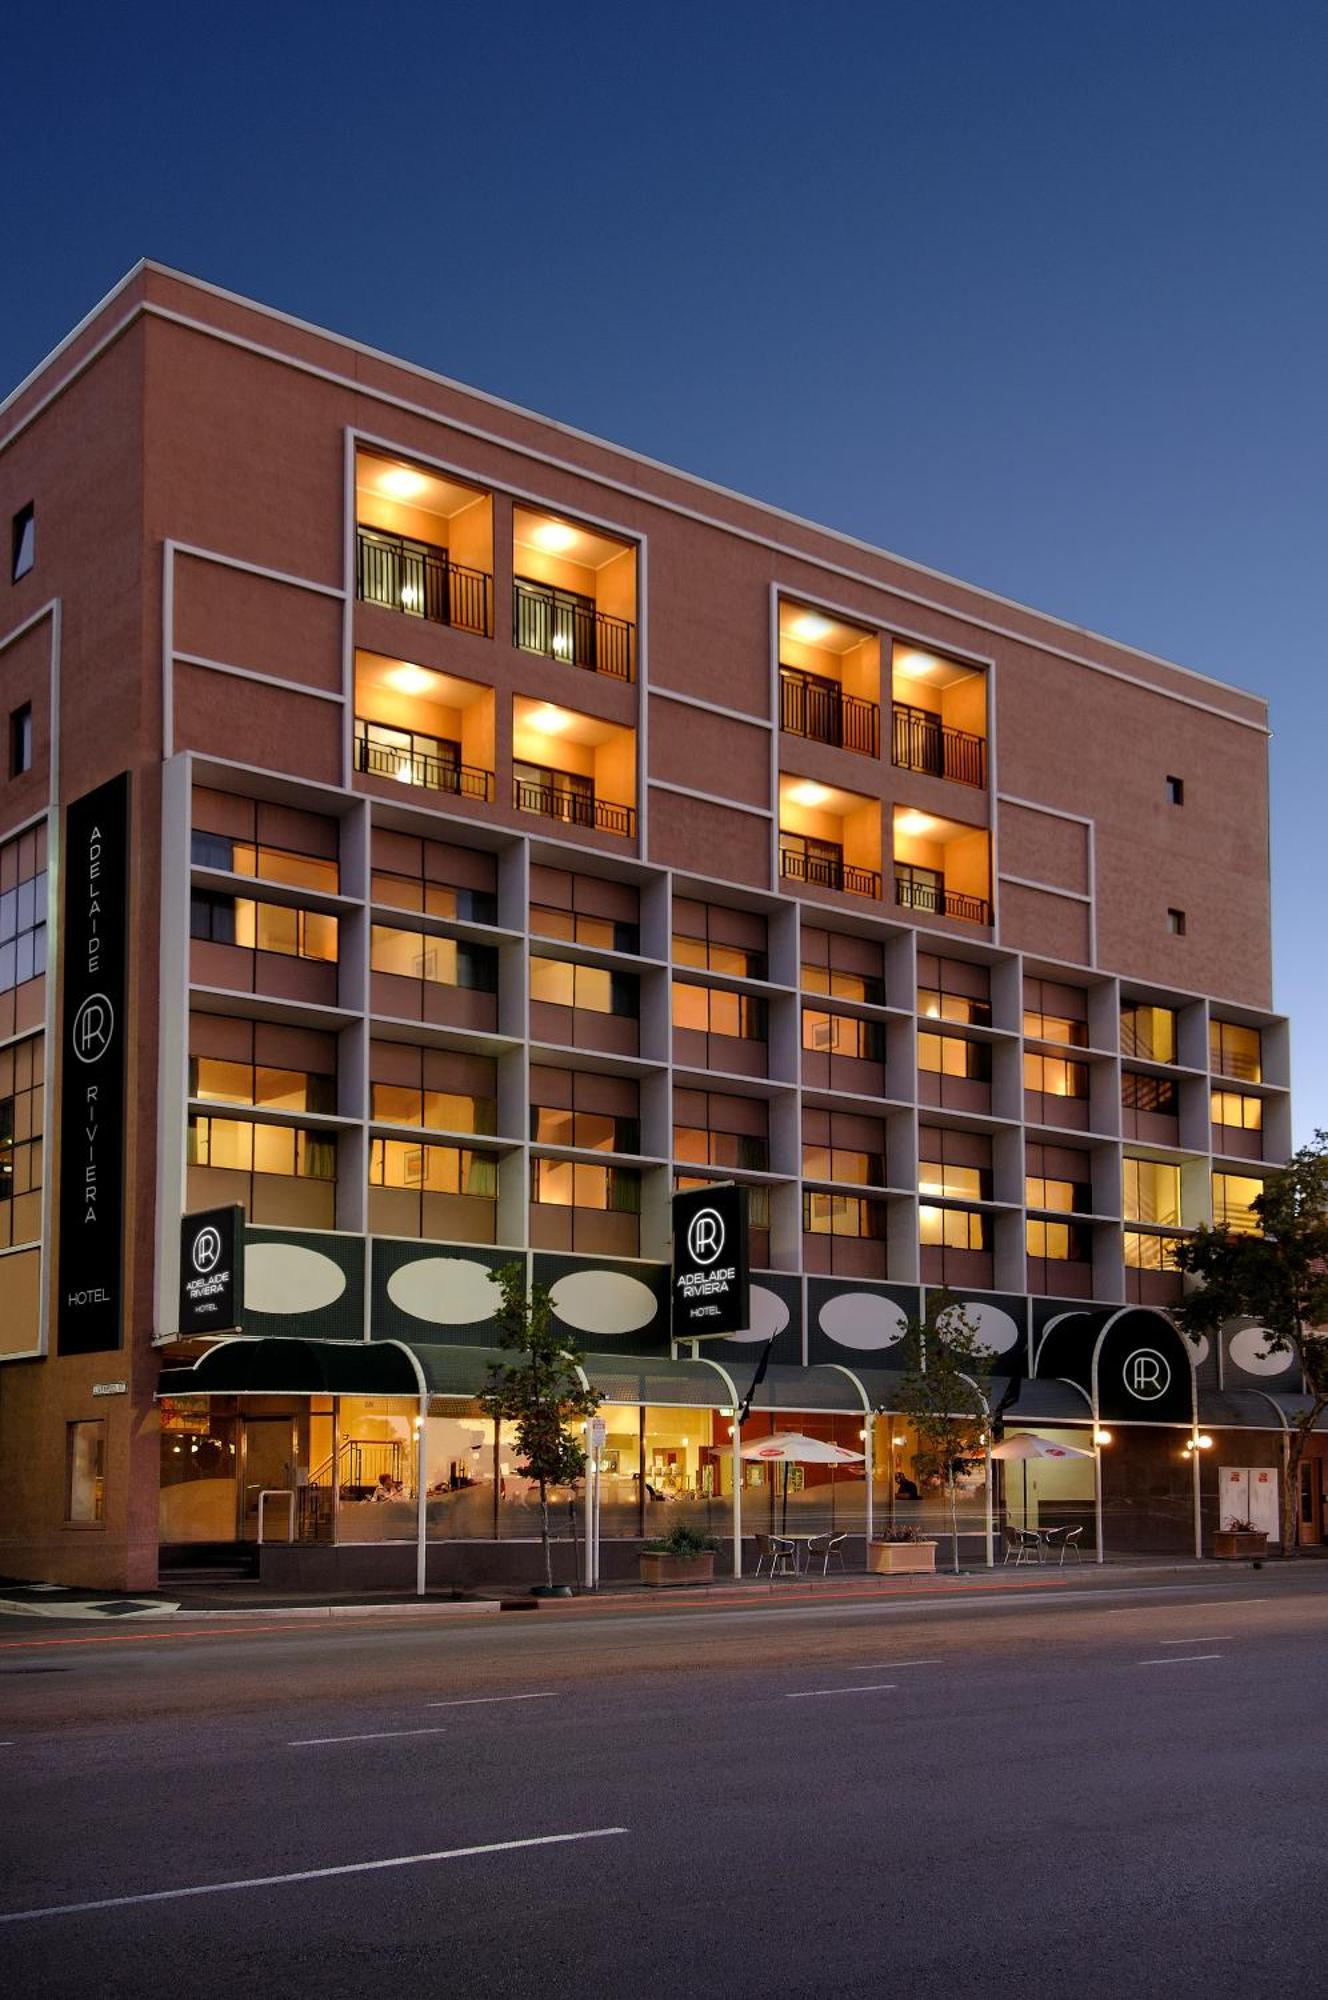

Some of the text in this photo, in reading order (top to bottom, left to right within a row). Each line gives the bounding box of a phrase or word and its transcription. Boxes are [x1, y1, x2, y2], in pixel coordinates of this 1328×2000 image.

[88, 826, 102, 973] ADELAIDE
[85, 1085, 98, 1223] RIVIERA
[186, 1272, 229, 1291] ADELAIDE
[677, 1268, 735, 1288] ADELAIDE
[68, 1288, 110, 1305] HOTEL
[190, 1283, 224, 1299] RIVIERA
[683, 1282, 729, 1298] RIVIERA
[195, 1303, 218, 1313] HOTEL
[690, 1305, 721, 1318] HOTEL
